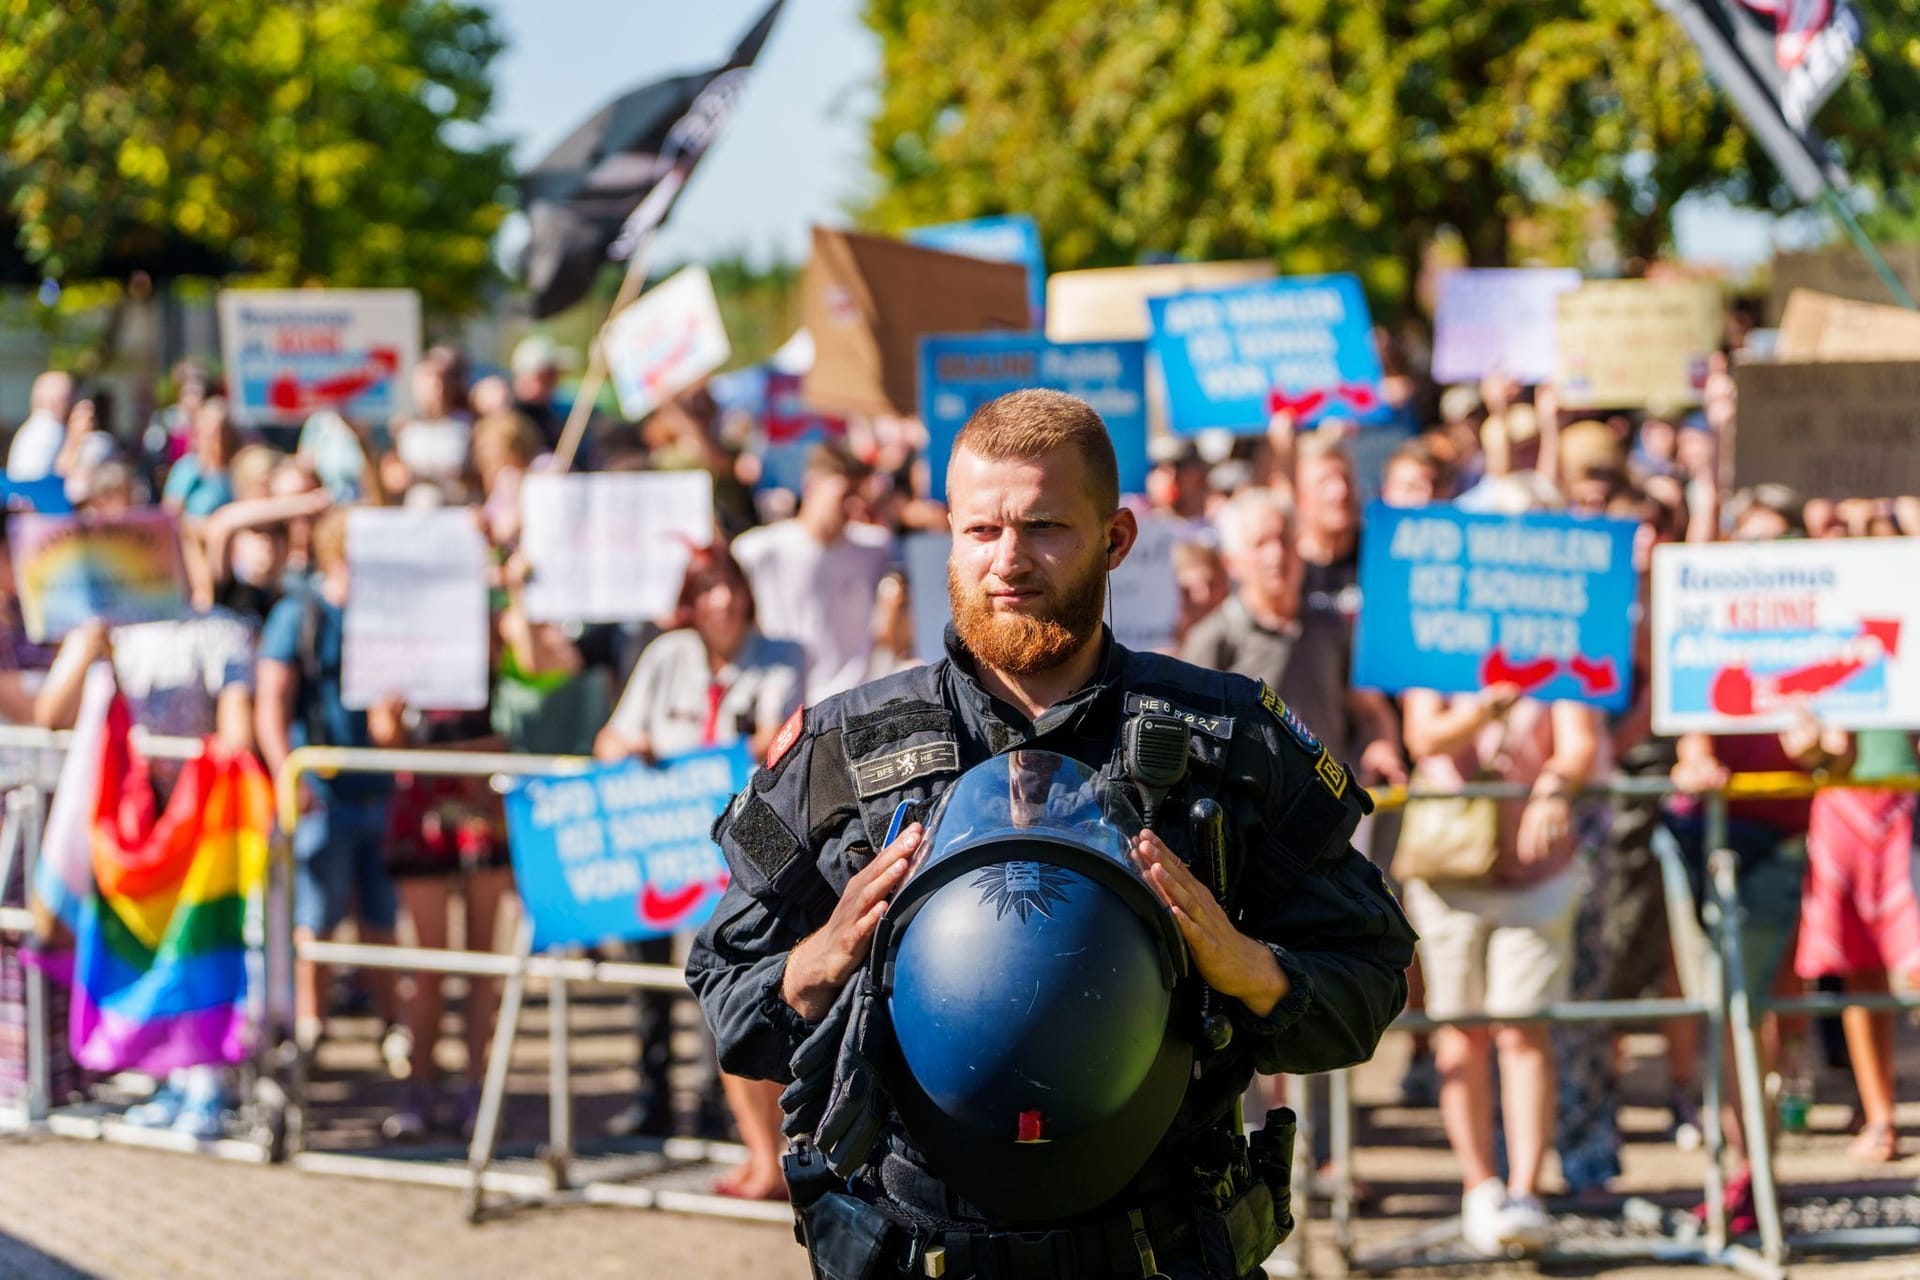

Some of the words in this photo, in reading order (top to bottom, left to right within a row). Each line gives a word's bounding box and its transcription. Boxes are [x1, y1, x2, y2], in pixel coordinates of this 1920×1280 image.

[1728, 598, 1815, 630] KEINE
[1411, 609, 1492, 652] VON
[1140, 700, 1159, 710] HE
[876, 766, 894, 778] BFE
